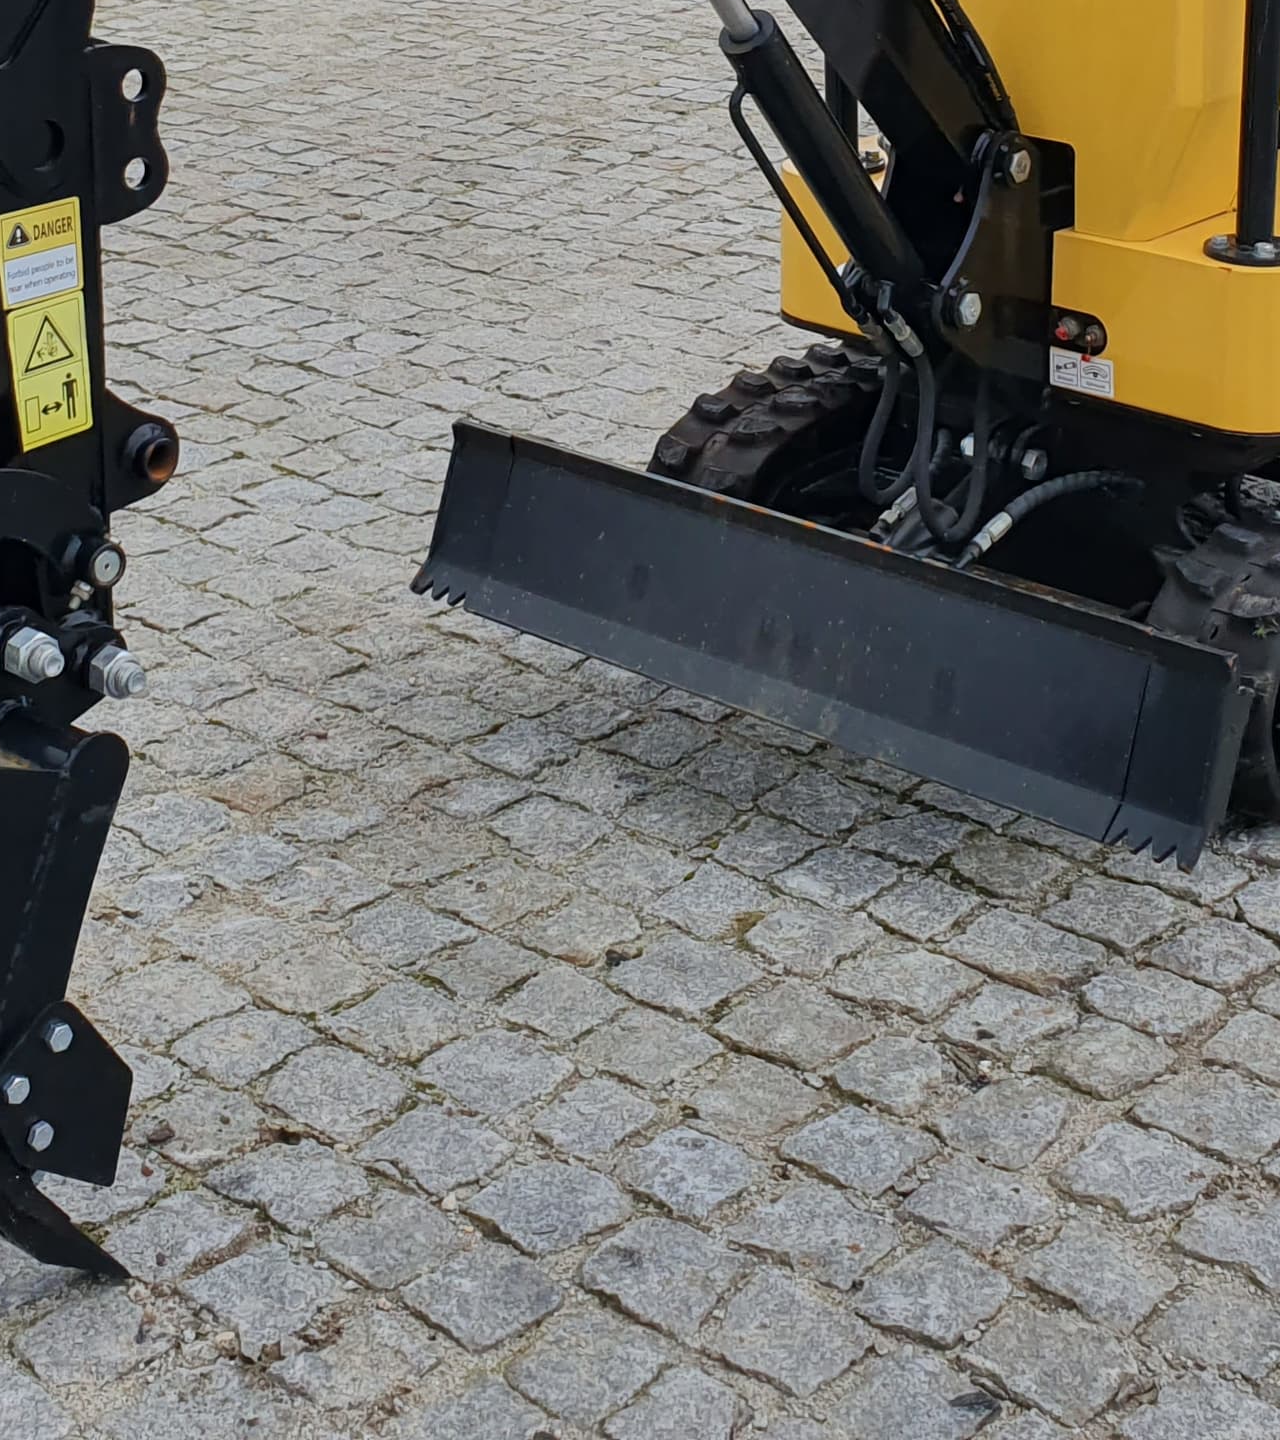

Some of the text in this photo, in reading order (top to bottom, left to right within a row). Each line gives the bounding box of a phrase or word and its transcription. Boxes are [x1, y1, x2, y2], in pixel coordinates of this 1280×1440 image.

[32, 215, 74, 241] DANGER
[30, 261, 55, 276] people
[55, 259, 65, 268] to
[23, 278, 43, 289] when
[43, 269, 76, 286] operating
